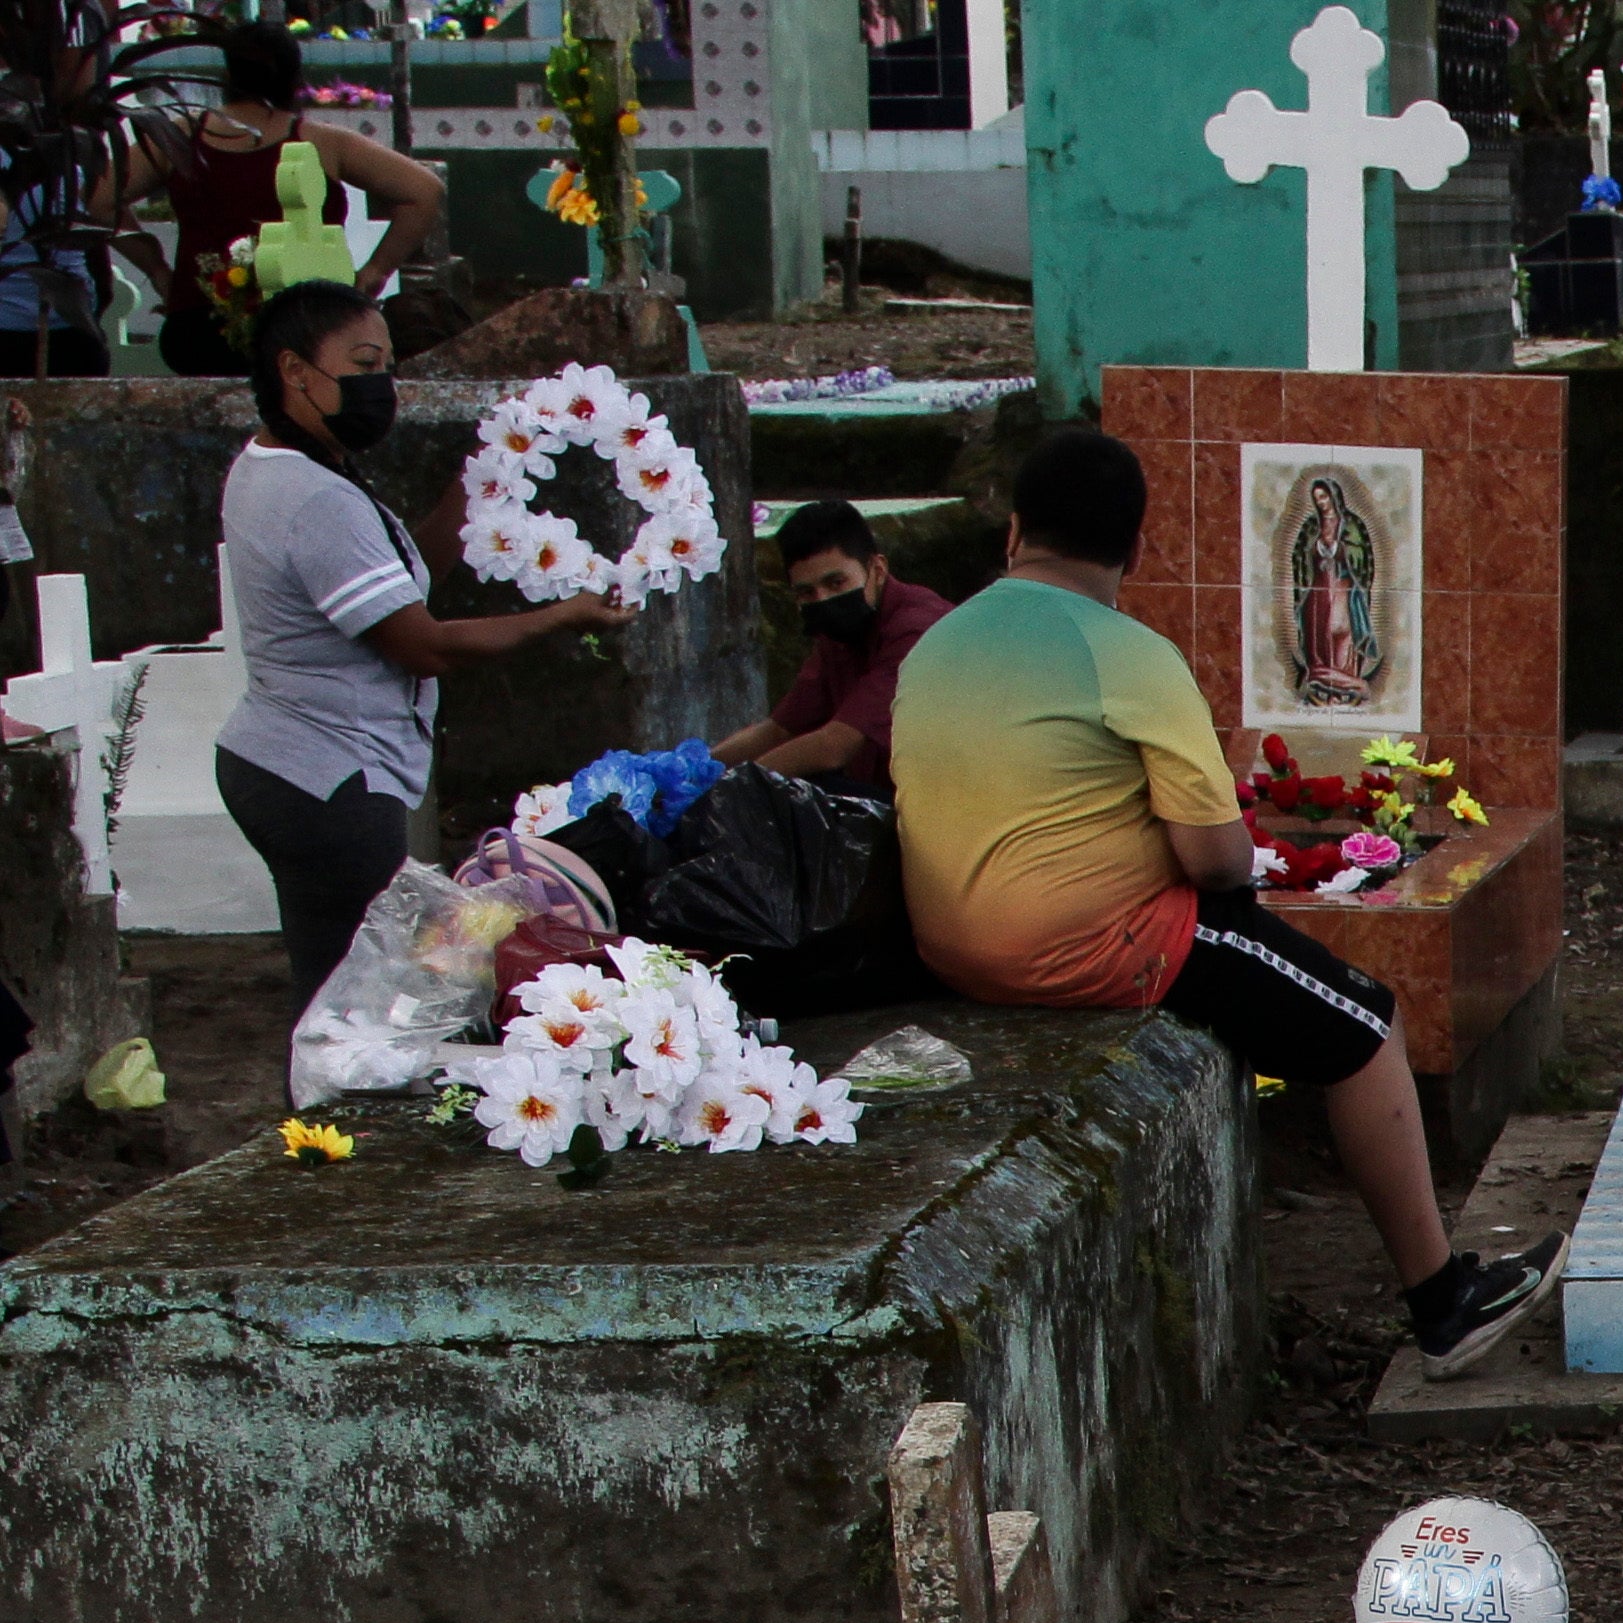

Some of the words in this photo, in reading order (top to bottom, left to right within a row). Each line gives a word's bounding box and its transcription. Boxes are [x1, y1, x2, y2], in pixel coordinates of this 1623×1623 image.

[1415, 1517, 1470, 1544] Eres
[1424, 1543, 1457, 1558] un
[1369, 1554, 1512, 1623] PAPÁ
